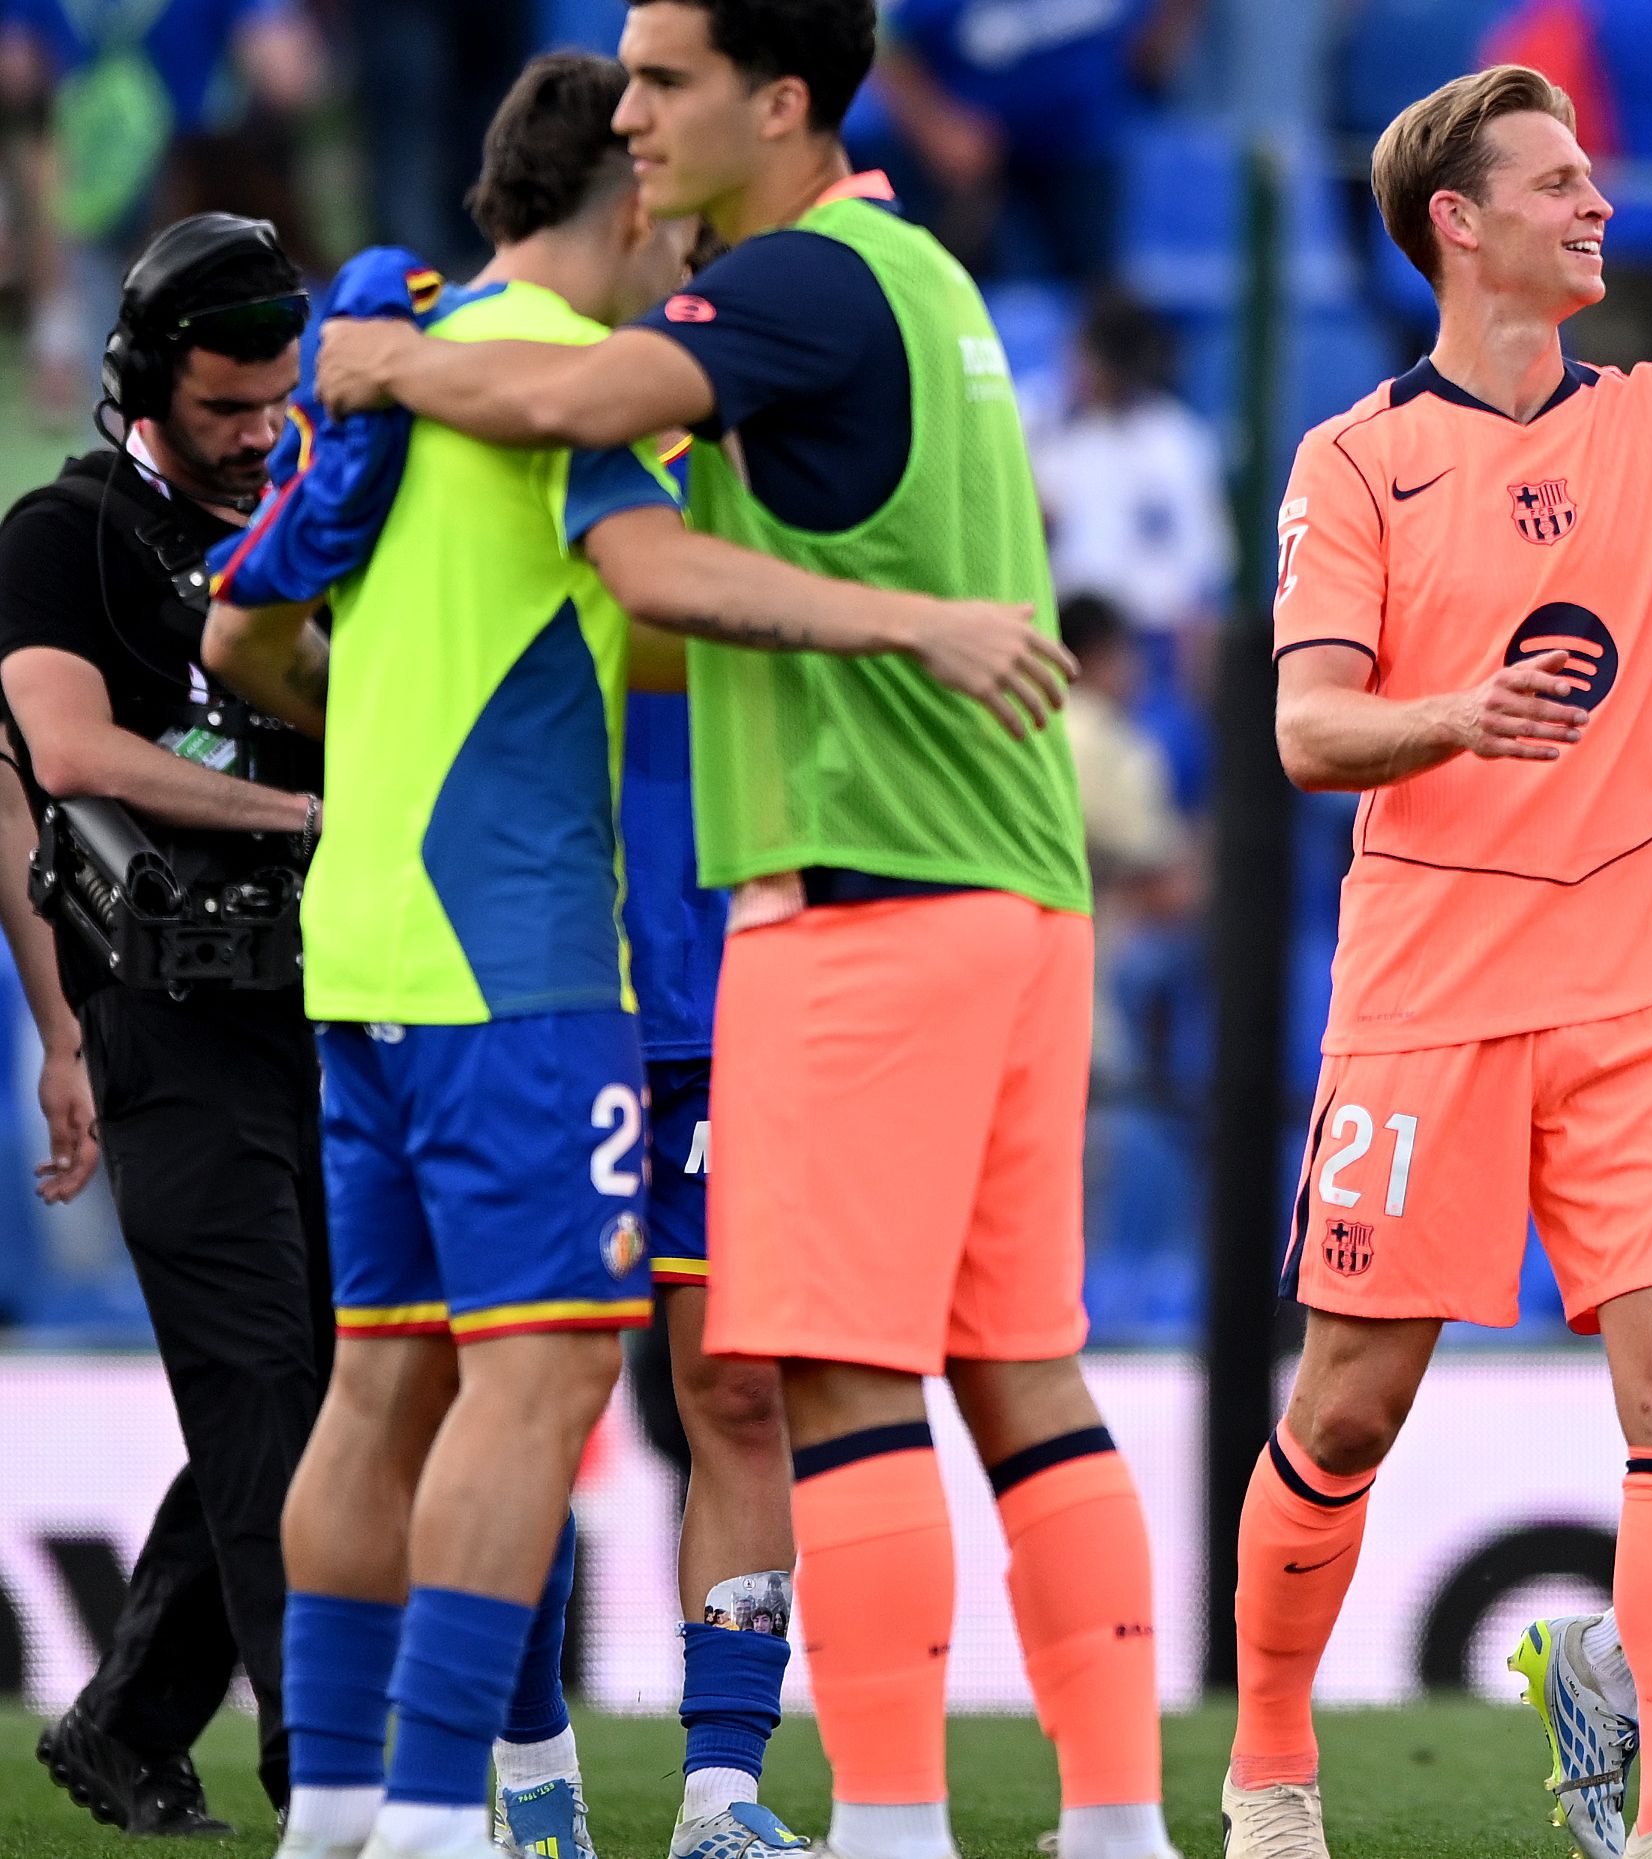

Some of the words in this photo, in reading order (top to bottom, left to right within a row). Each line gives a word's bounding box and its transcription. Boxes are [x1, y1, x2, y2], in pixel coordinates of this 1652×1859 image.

[590, 1083, 653, 1197] 2
[1318, 1104, 1418, 1218] 21
[518, 1791, 538, 1803] 1994
[537, 1782, 555, 1796] EST.
